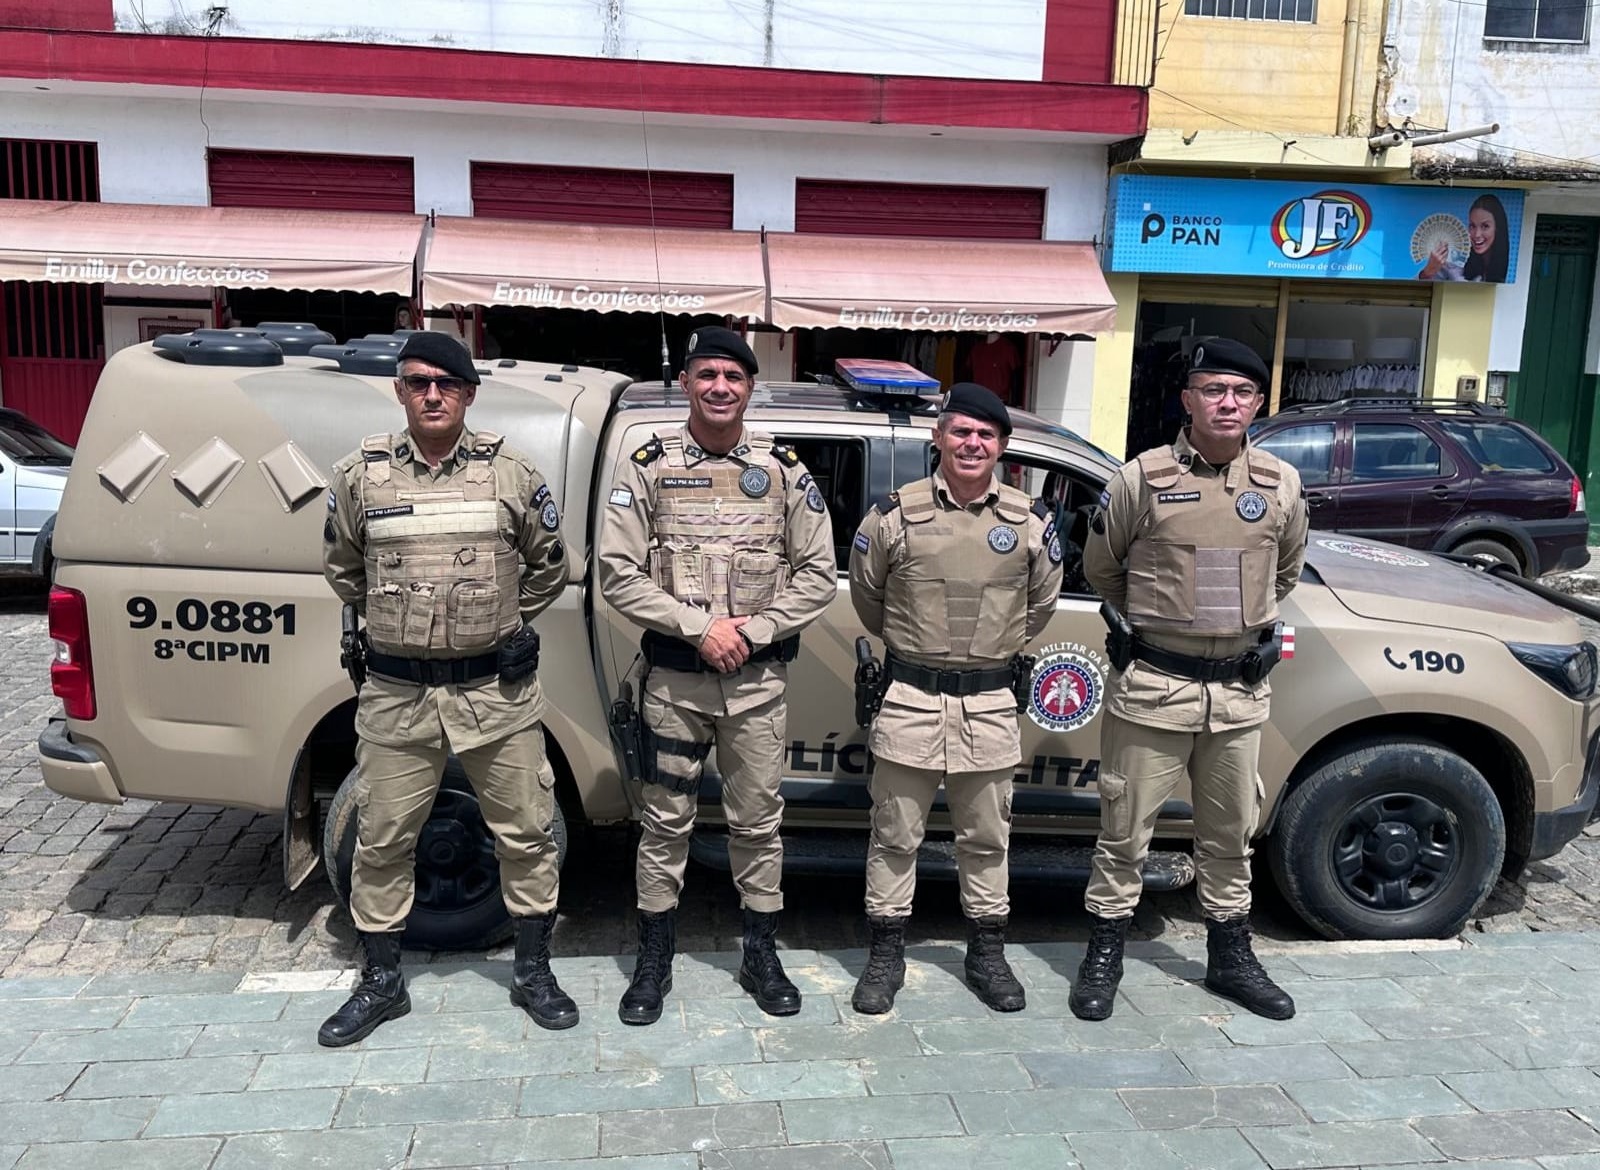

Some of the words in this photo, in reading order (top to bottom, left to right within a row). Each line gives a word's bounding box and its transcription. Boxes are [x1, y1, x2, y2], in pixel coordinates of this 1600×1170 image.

[1172, 215, 1223, 227] BANCO
[1281, 198, 1355, 260] JF
[1171, 227, 1221, 247] PAN
[127, 259, 270, 286] Confecções
[1317, 262, 1329, 272] de
[571, 285, 705, 311] Confecções
[911, 306, 1038, 330] Confecções
[126, 596, 296, 636] 9.0881
[1040, 642, 1087, 656] MILITAR
[1088, 650, 1102, 665] DA
[1409, 650, 1465, 674] 190
